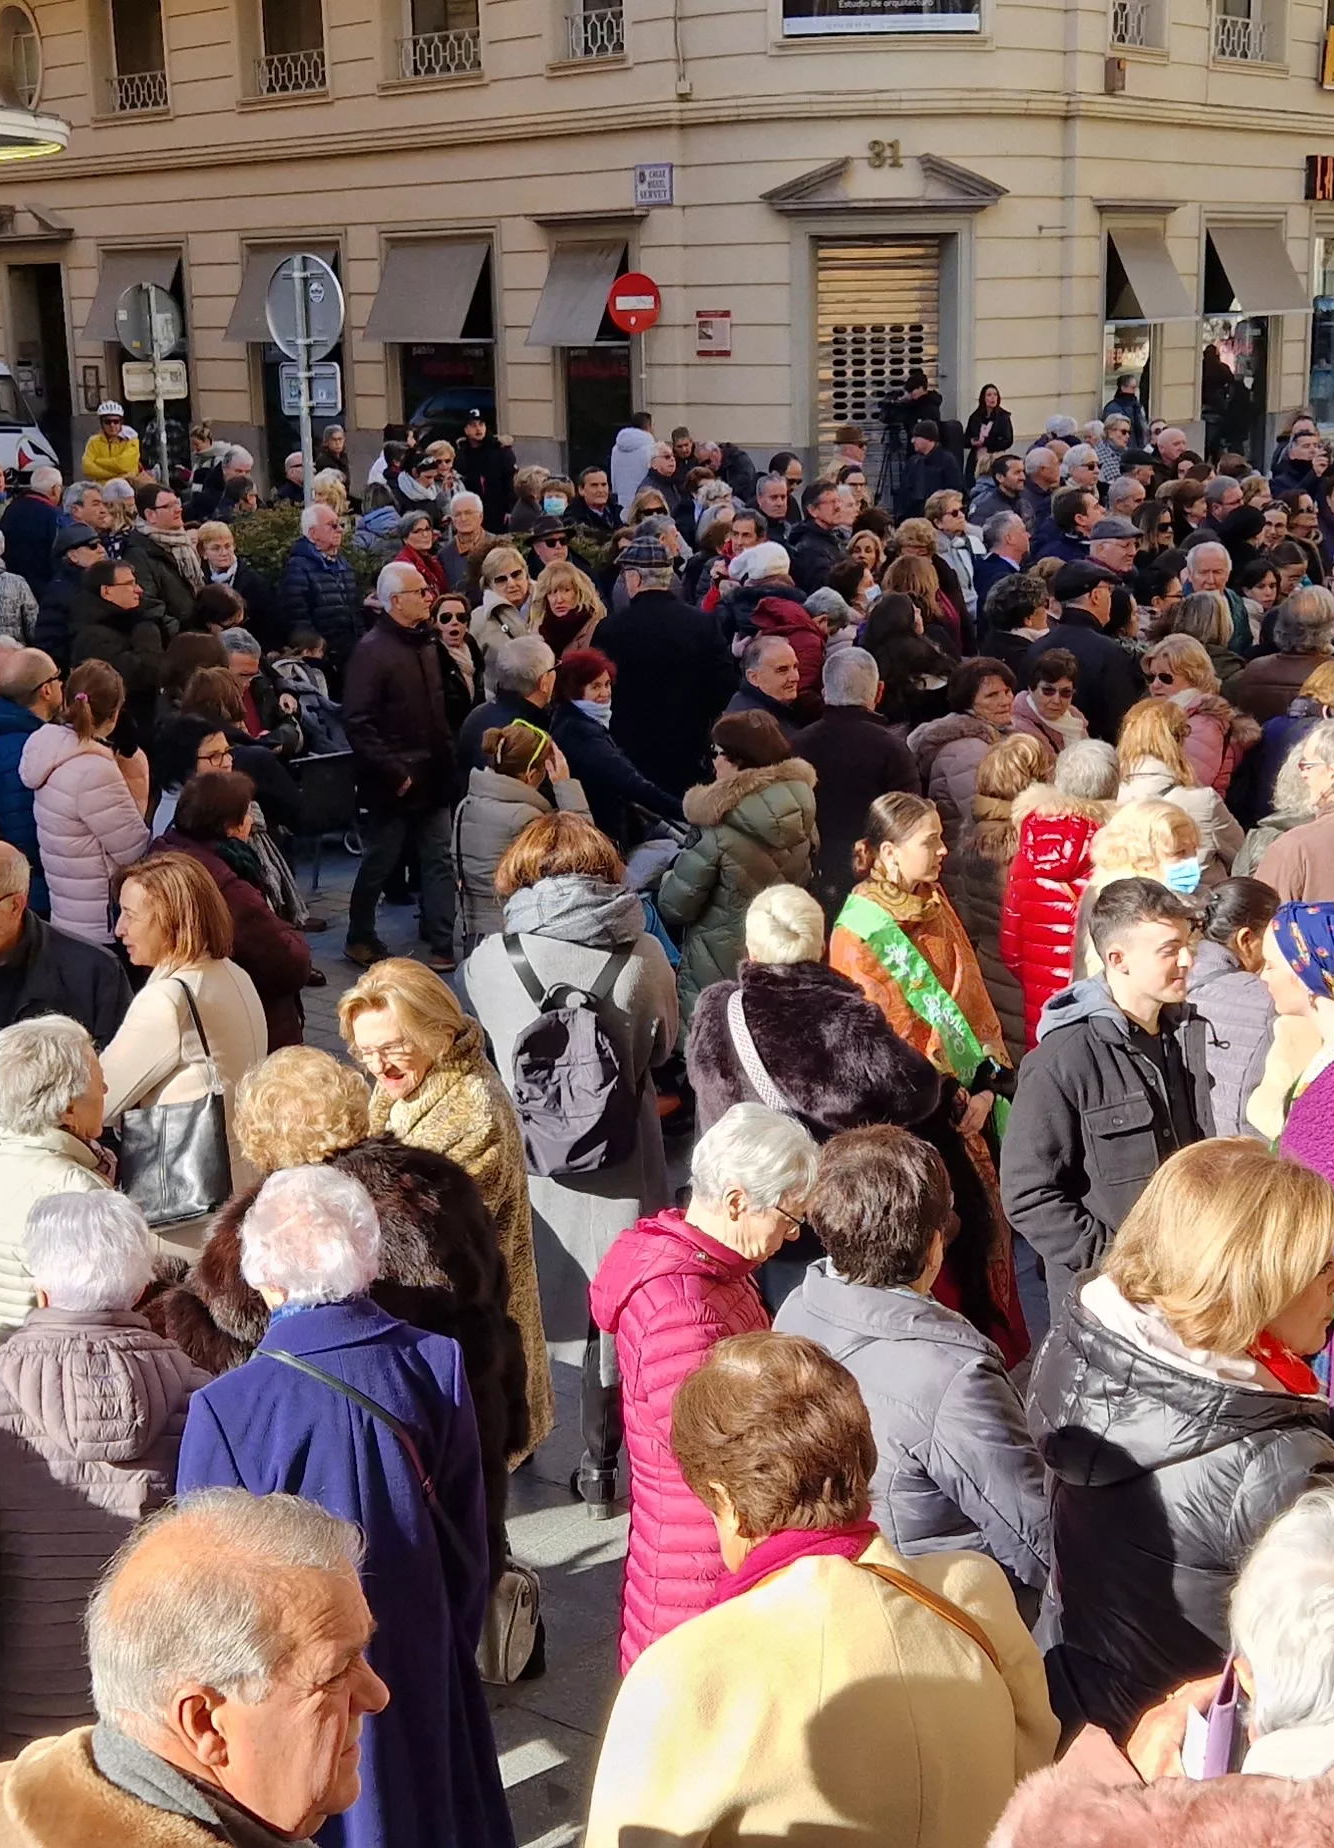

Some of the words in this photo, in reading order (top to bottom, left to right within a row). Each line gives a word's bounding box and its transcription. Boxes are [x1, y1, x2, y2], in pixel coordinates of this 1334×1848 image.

[868, 139, 904, 169] 31
[1316, 155, 1334, 200] LA
[640, 190, 668, 200] SERVET
